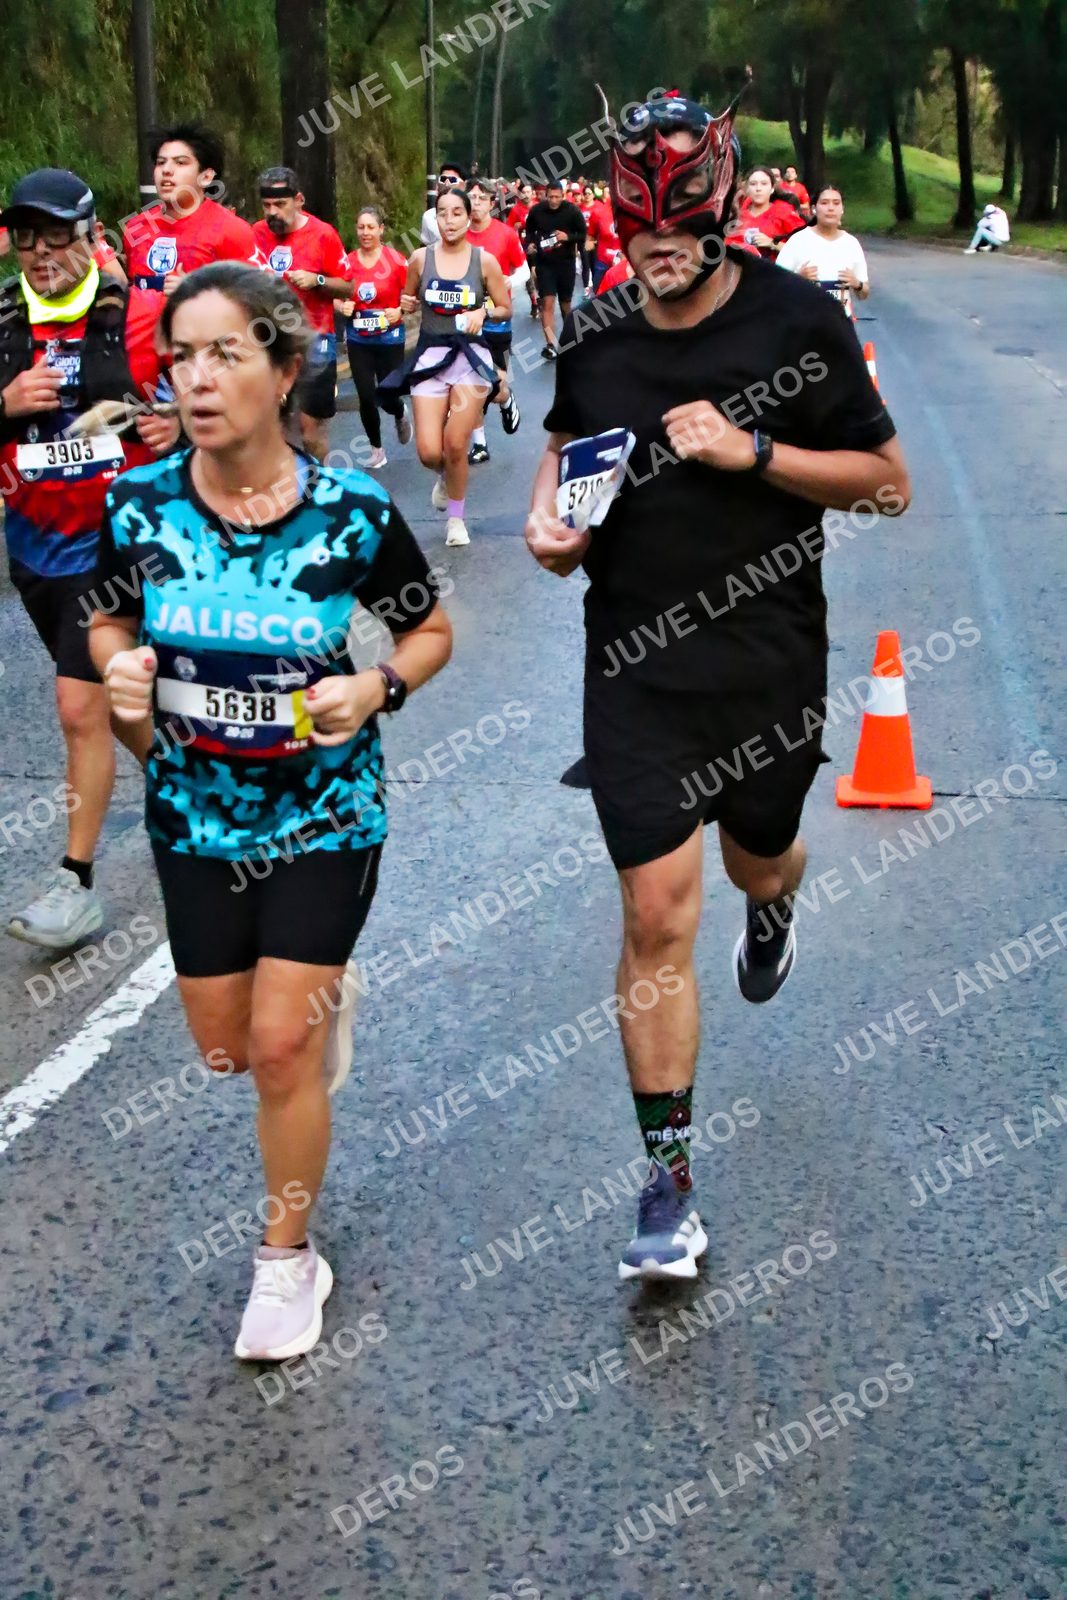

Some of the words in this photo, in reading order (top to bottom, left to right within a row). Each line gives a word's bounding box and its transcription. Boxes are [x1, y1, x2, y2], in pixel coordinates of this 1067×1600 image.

[439, 292, 461, 303] 4069
[46, 441, 94, 465] 3903
[152, 602, 323, 647] JALISCO
[205, 687, 276, 722] 5638
